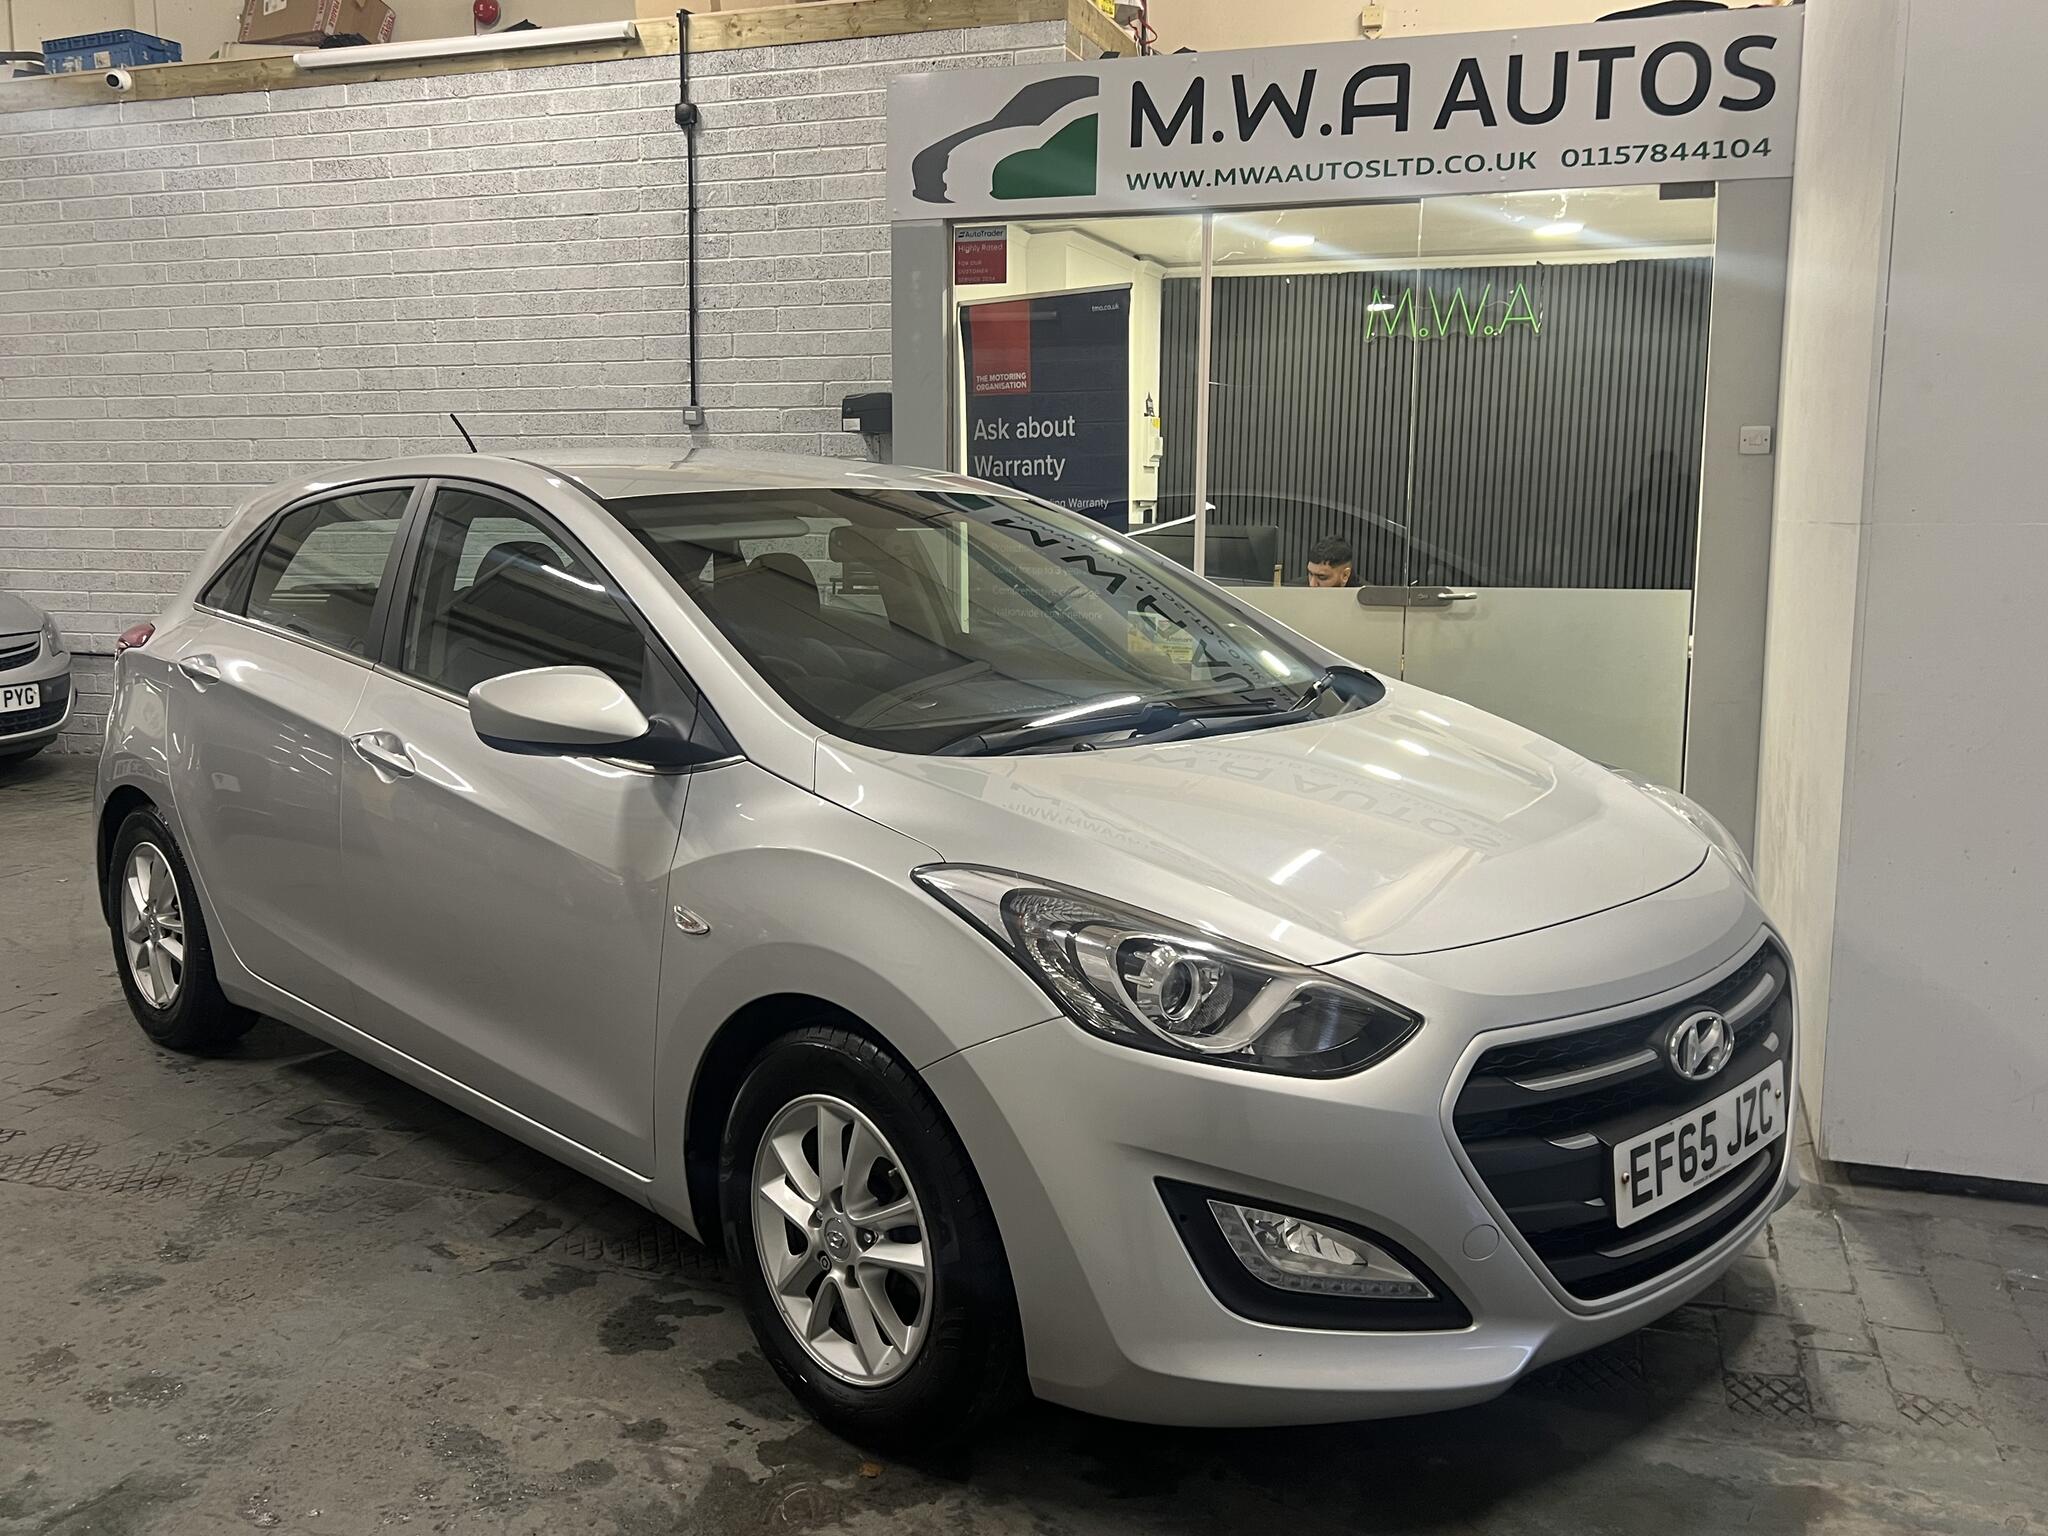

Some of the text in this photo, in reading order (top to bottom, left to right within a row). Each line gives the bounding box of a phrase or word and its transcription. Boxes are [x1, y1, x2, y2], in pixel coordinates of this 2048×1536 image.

[1130, 35, 1777, 148] M.W.A AUTOS
[1126, 138, 1772, 191] WWW.MWAAUTOSLTD.CO.UK 01157844104
[965, 229, 1004, 238] AutoTrader
[1365, 281, 1540, 341] M.W.A
[975, 371, 1027, 383] THE MOTORING
[975, 380, 1027, 391] ORGANISATION
[973, 415, 1076, 441] Ask about
[974, 454, 1066, 481] Warranty
[1068, 498, 1109, 510] Warranty
[3, 687, 34, 708] PYG
[1629, 1078, 1773, 1209] EF65 JZC
